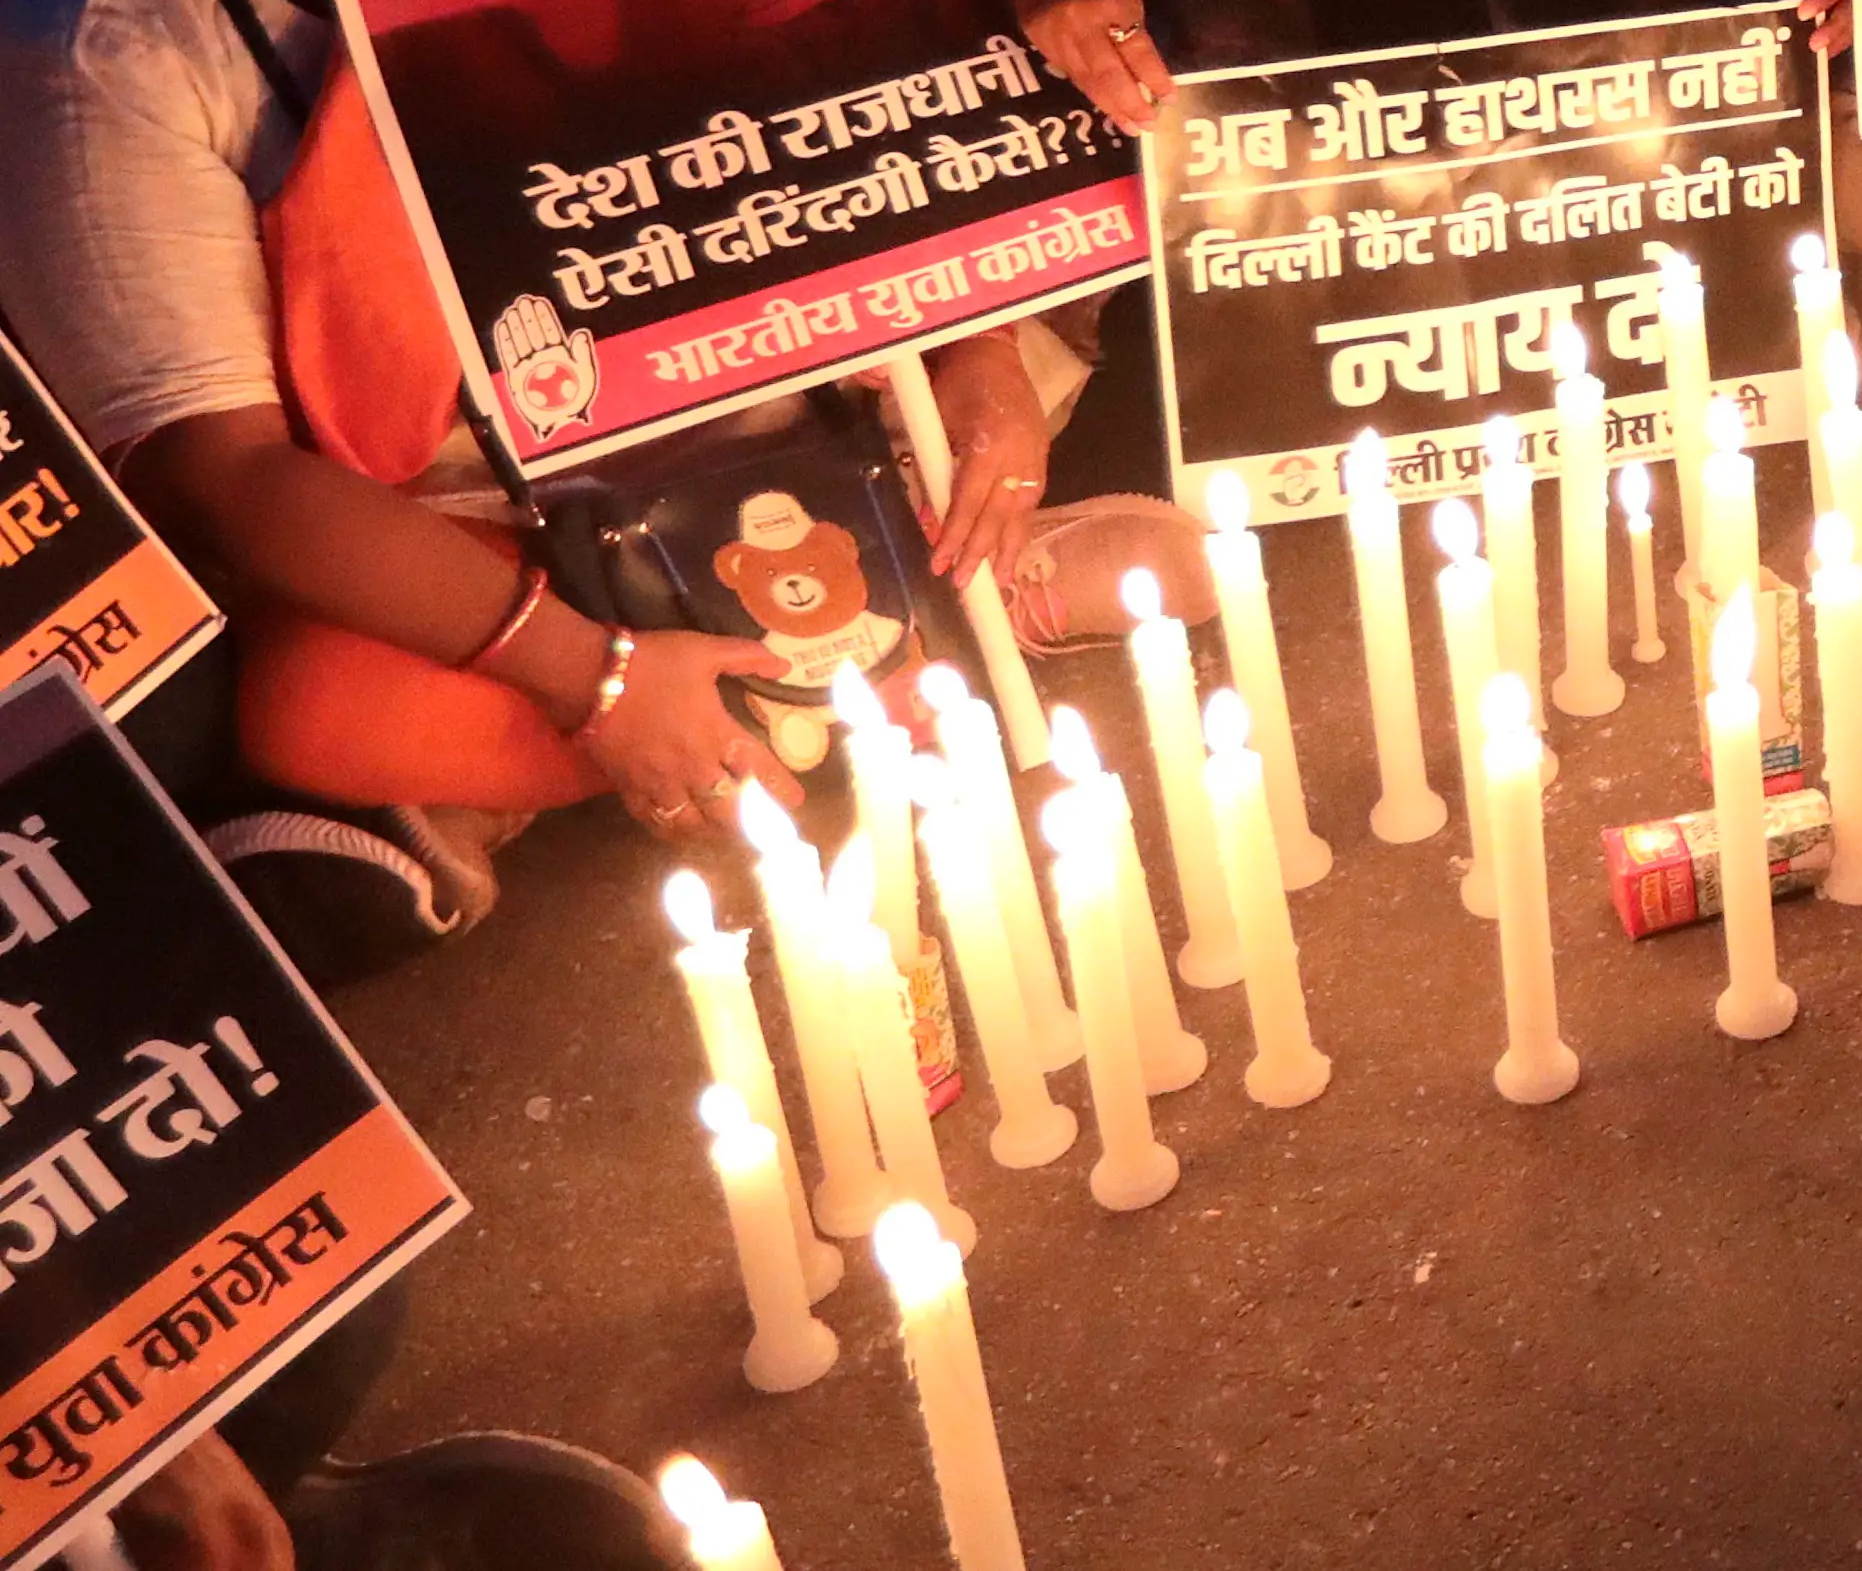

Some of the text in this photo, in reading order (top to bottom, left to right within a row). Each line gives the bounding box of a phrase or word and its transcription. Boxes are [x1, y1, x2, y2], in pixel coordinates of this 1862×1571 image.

[522, 151, 662, 232] देश
[660, 107, 771, 193] की
[770, 33, 1043, 163] राजधानी
[1182, 25, 1792, 177] अब और हाथरस नहीं
[552, 209, 696, 313] ऐसी
[690, 151, 931, 266] दरिंदगी
[645, 202, 1137, 385] भारतीय युवा कांग्रेस
[1184, 145, 1804, 294] दिल्ली कैंट की दलित बेटी को
[1316, 285, 1583, 408] न्याय
[0, 1190, 350, 1488] युवा कांग्रेस
